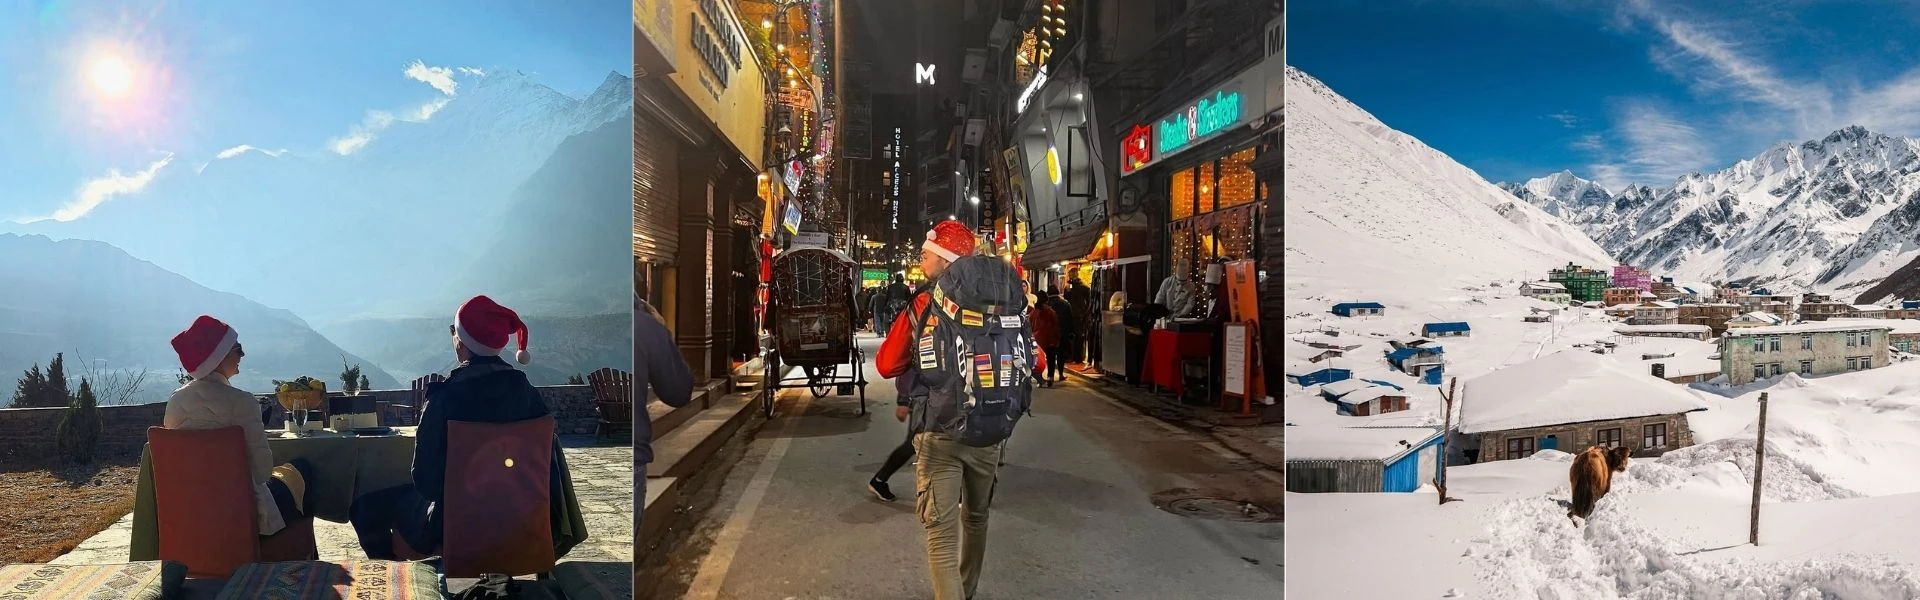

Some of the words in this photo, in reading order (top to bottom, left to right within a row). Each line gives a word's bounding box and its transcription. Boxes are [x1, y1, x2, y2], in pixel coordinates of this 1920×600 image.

[916, 62, 935, 85] M
[1187, 106, 1197, 140] &
[1197, 91, 1238, 136] Sizzlers
